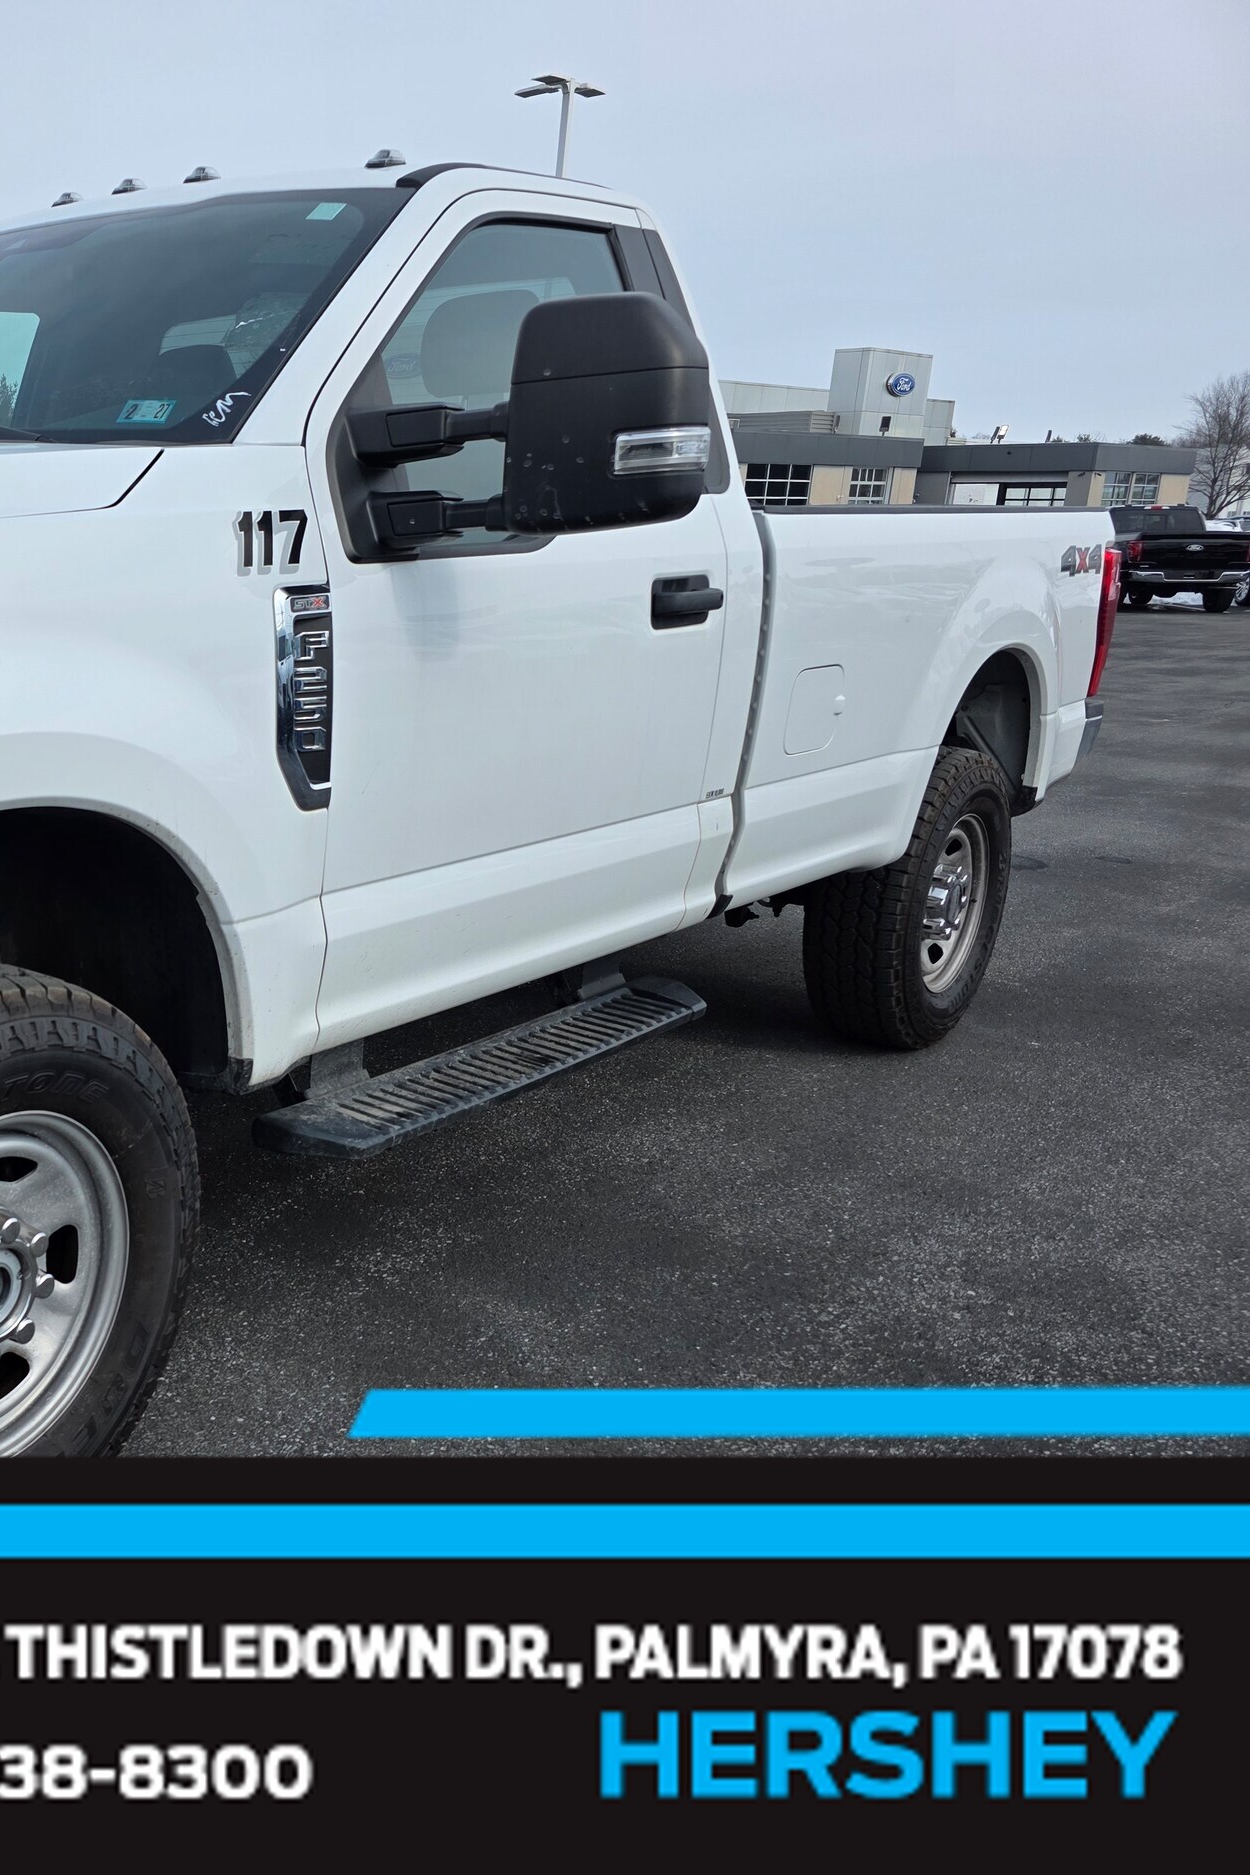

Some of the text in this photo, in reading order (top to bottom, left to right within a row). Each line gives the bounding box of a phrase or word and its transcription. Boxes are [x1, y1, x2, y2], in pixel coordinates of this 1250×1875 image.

[124, 403, 139, 420] 2
[153, 403, 171, 420] 27
[234, 508, 308, 571] 117
[293, 597, 328, 611] STX
[293, 631, 330, 750] F250
